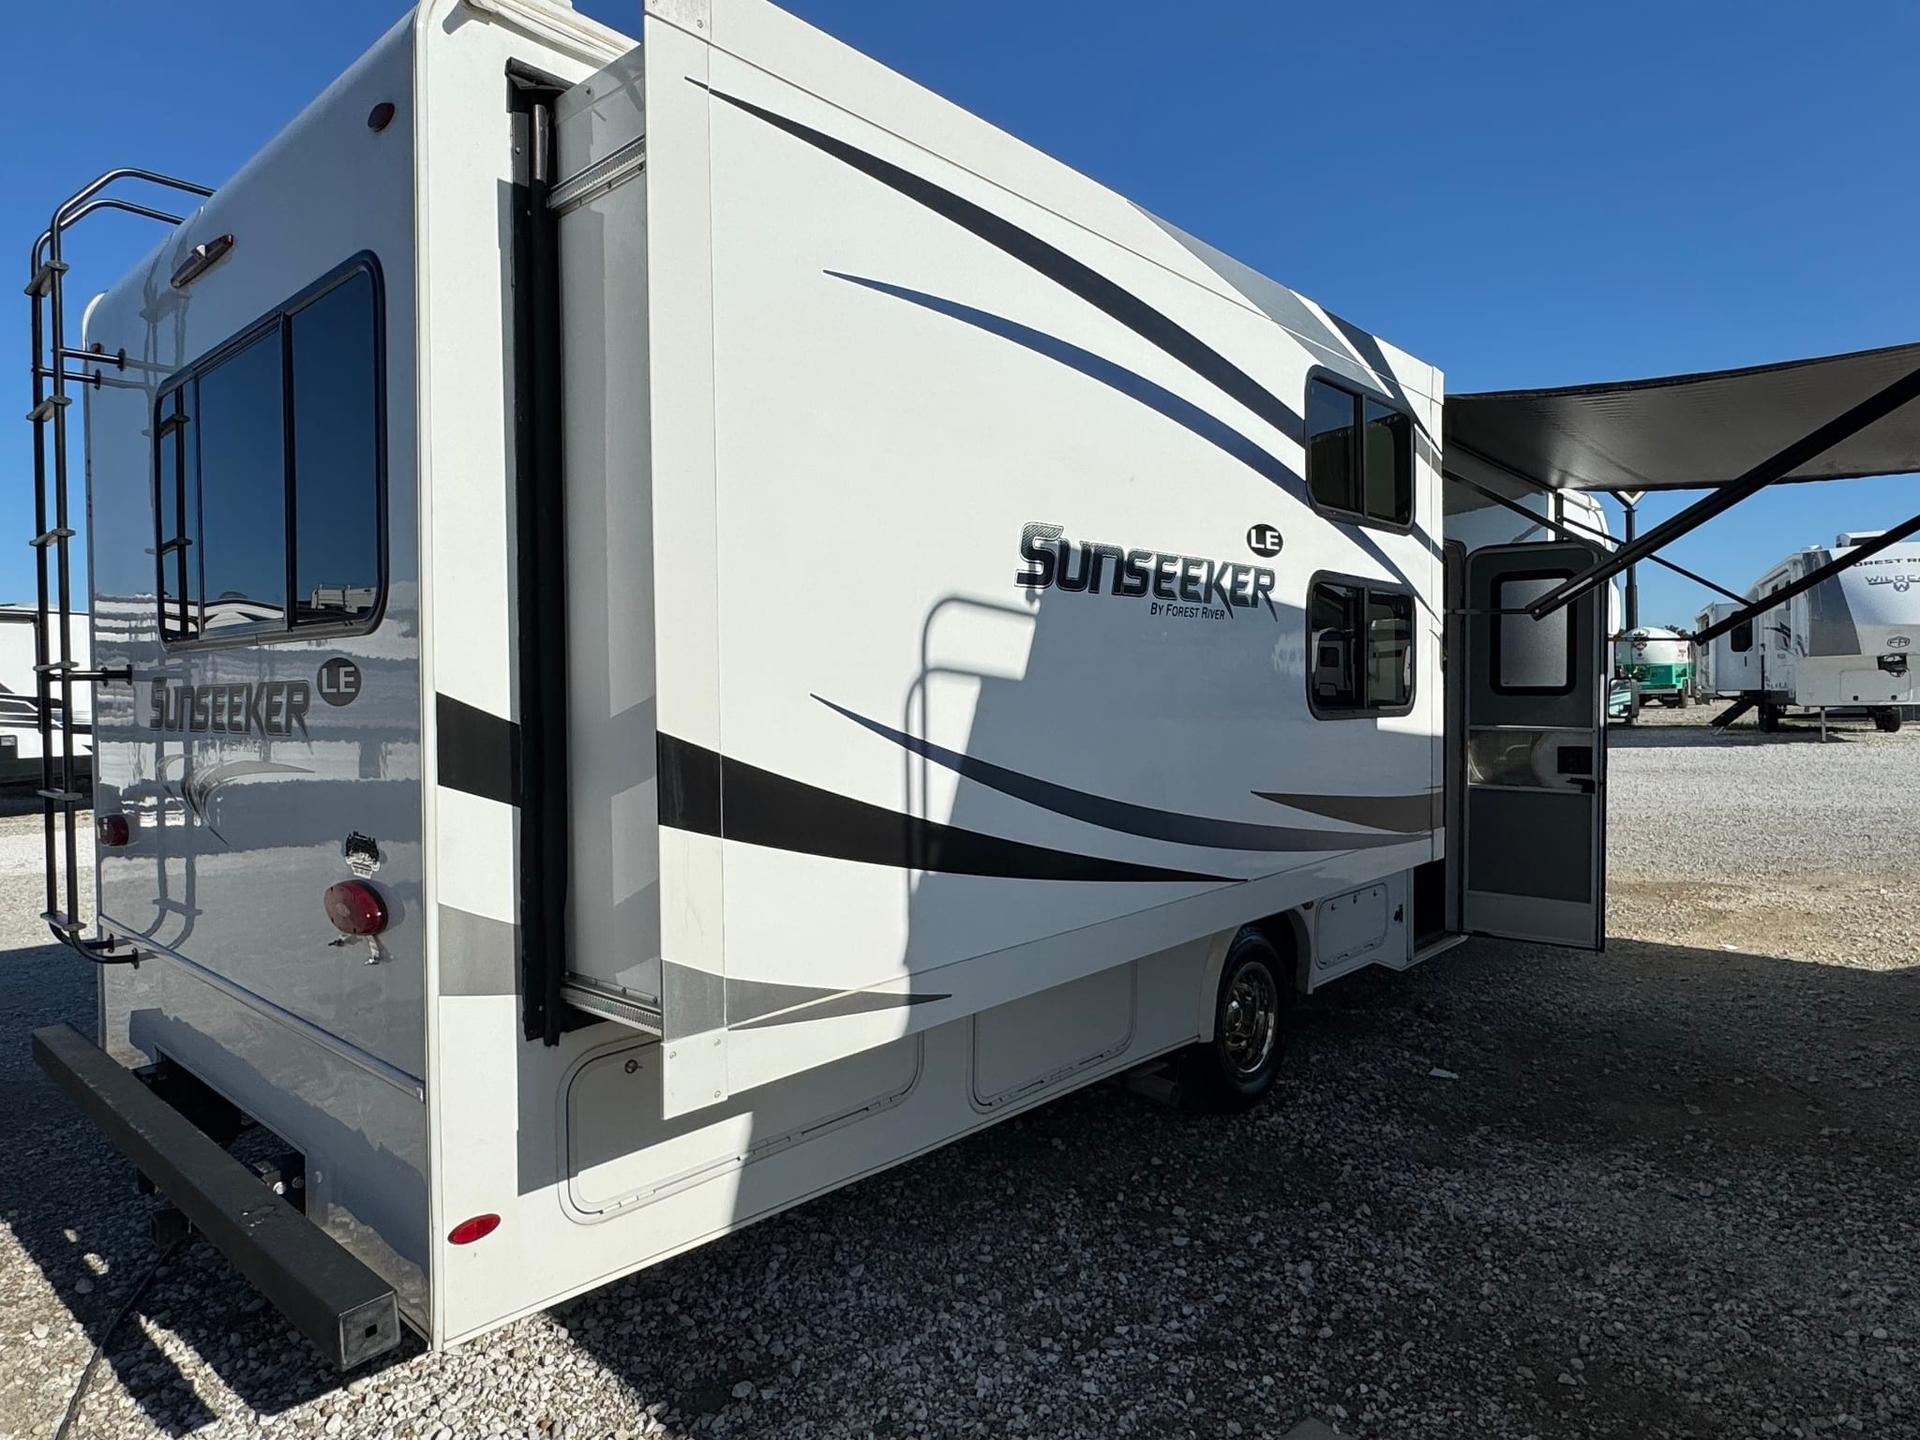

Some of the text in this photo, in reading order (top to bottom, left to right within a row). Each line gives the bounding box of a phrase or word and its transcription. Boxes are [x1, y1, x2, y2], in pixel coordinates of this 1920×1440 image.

[1250, 528, 1280, 551] LE
[1853, 559, 1902, 567] OREST
[321, 665, 356, 694] LE
